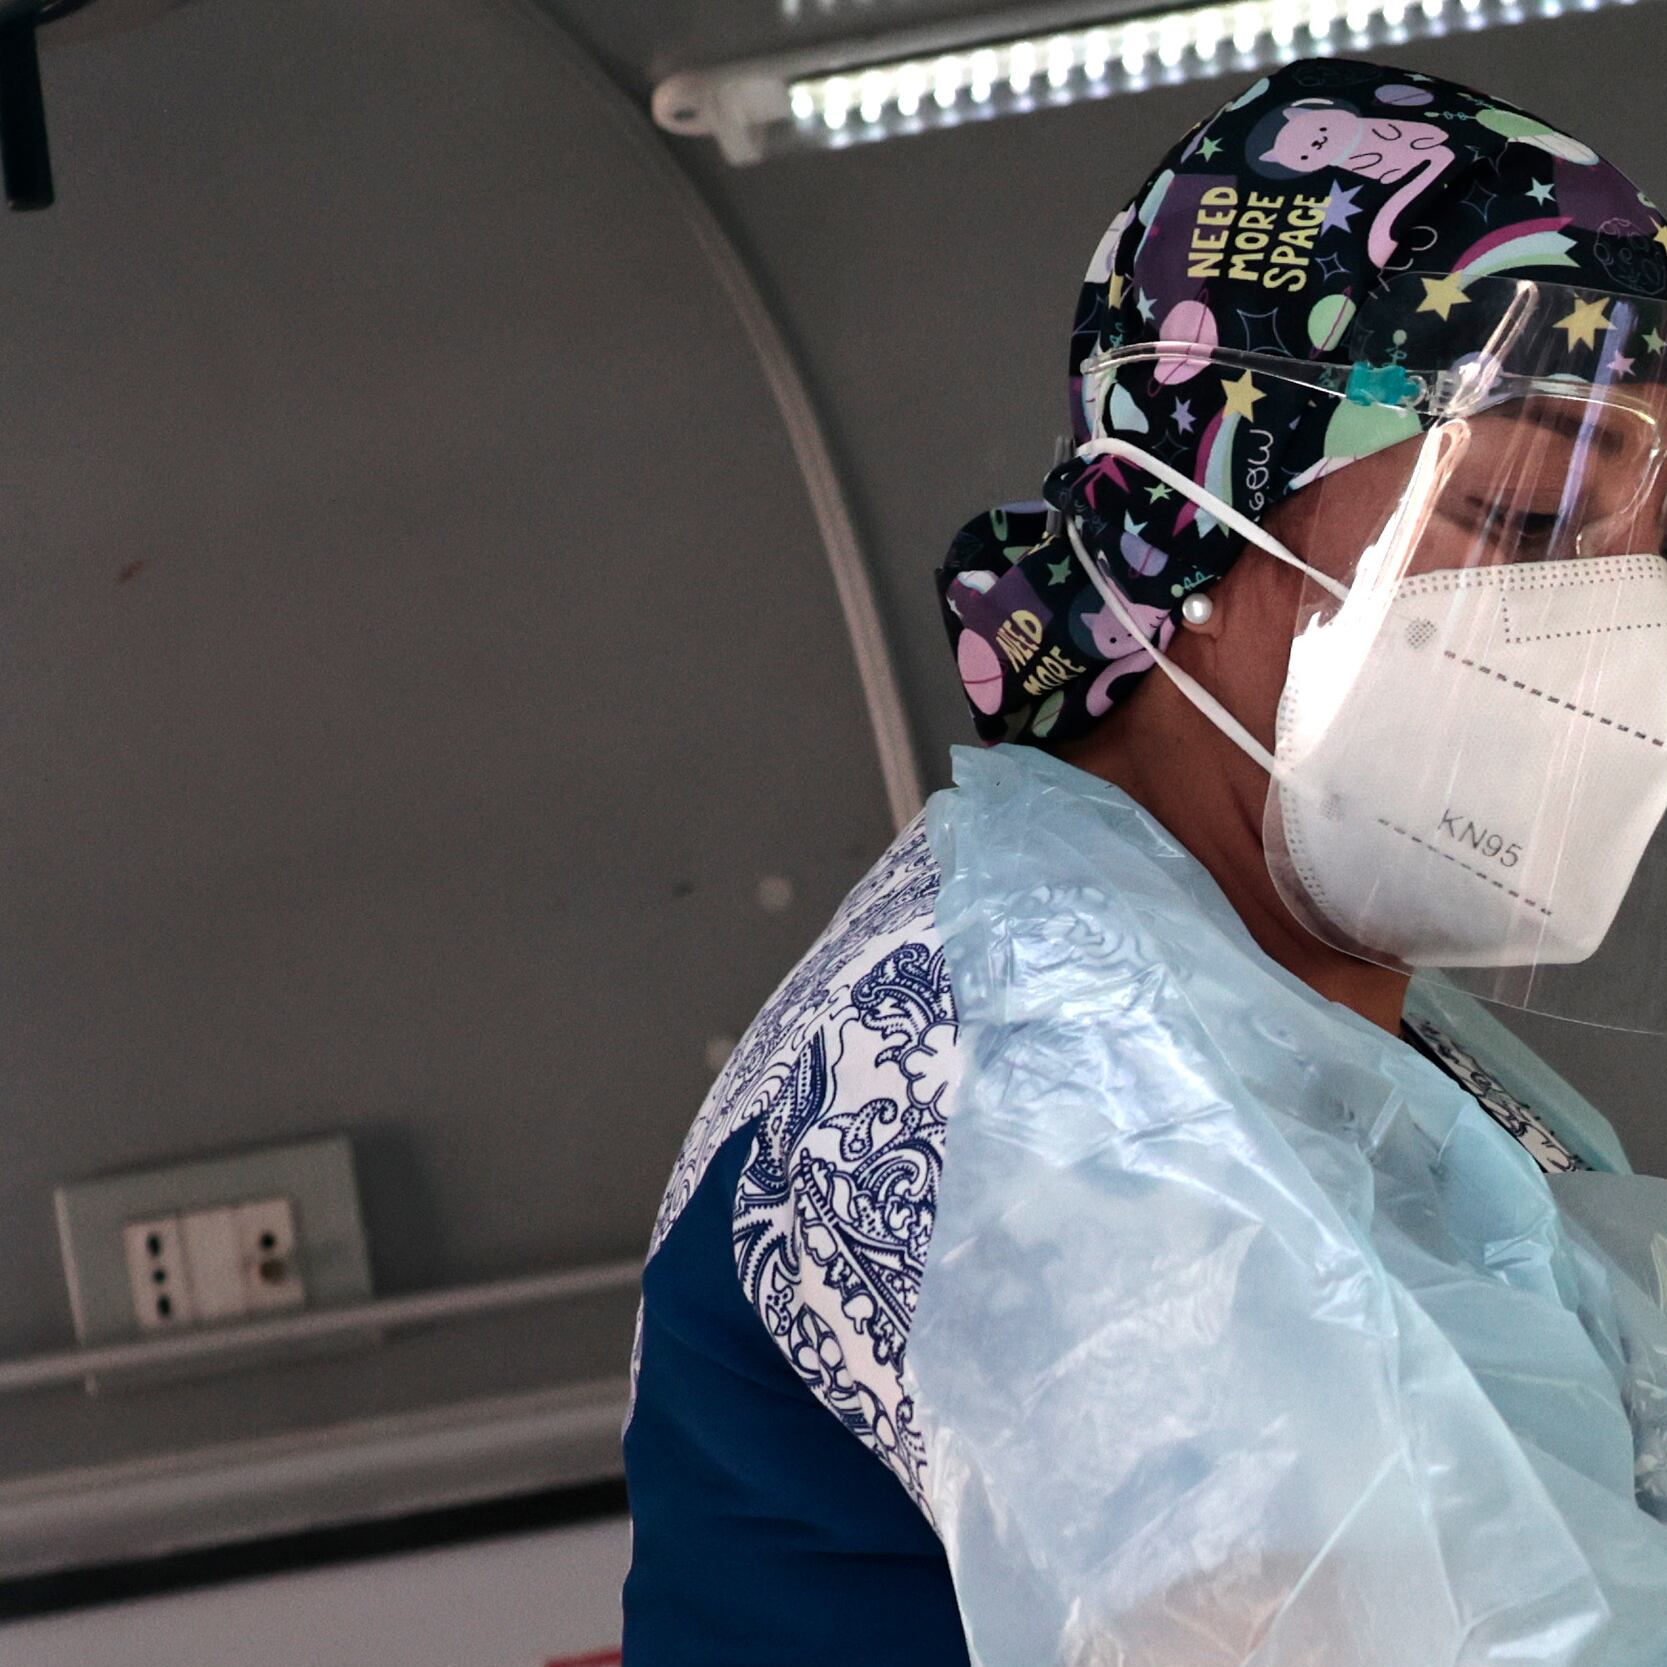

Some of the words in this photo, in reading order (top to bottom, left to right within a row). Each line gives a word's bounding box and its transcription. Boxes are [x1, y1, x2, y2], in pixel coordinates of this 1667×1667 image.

[1187, 186, 1239, 278] NEED
[1228, 191, 1286, 281] MORE
[1262, 193, 1333, 292] SPACE
[1022, 645, 1087, 696] MORE
[1437, 808, 1523, 868] KN95
